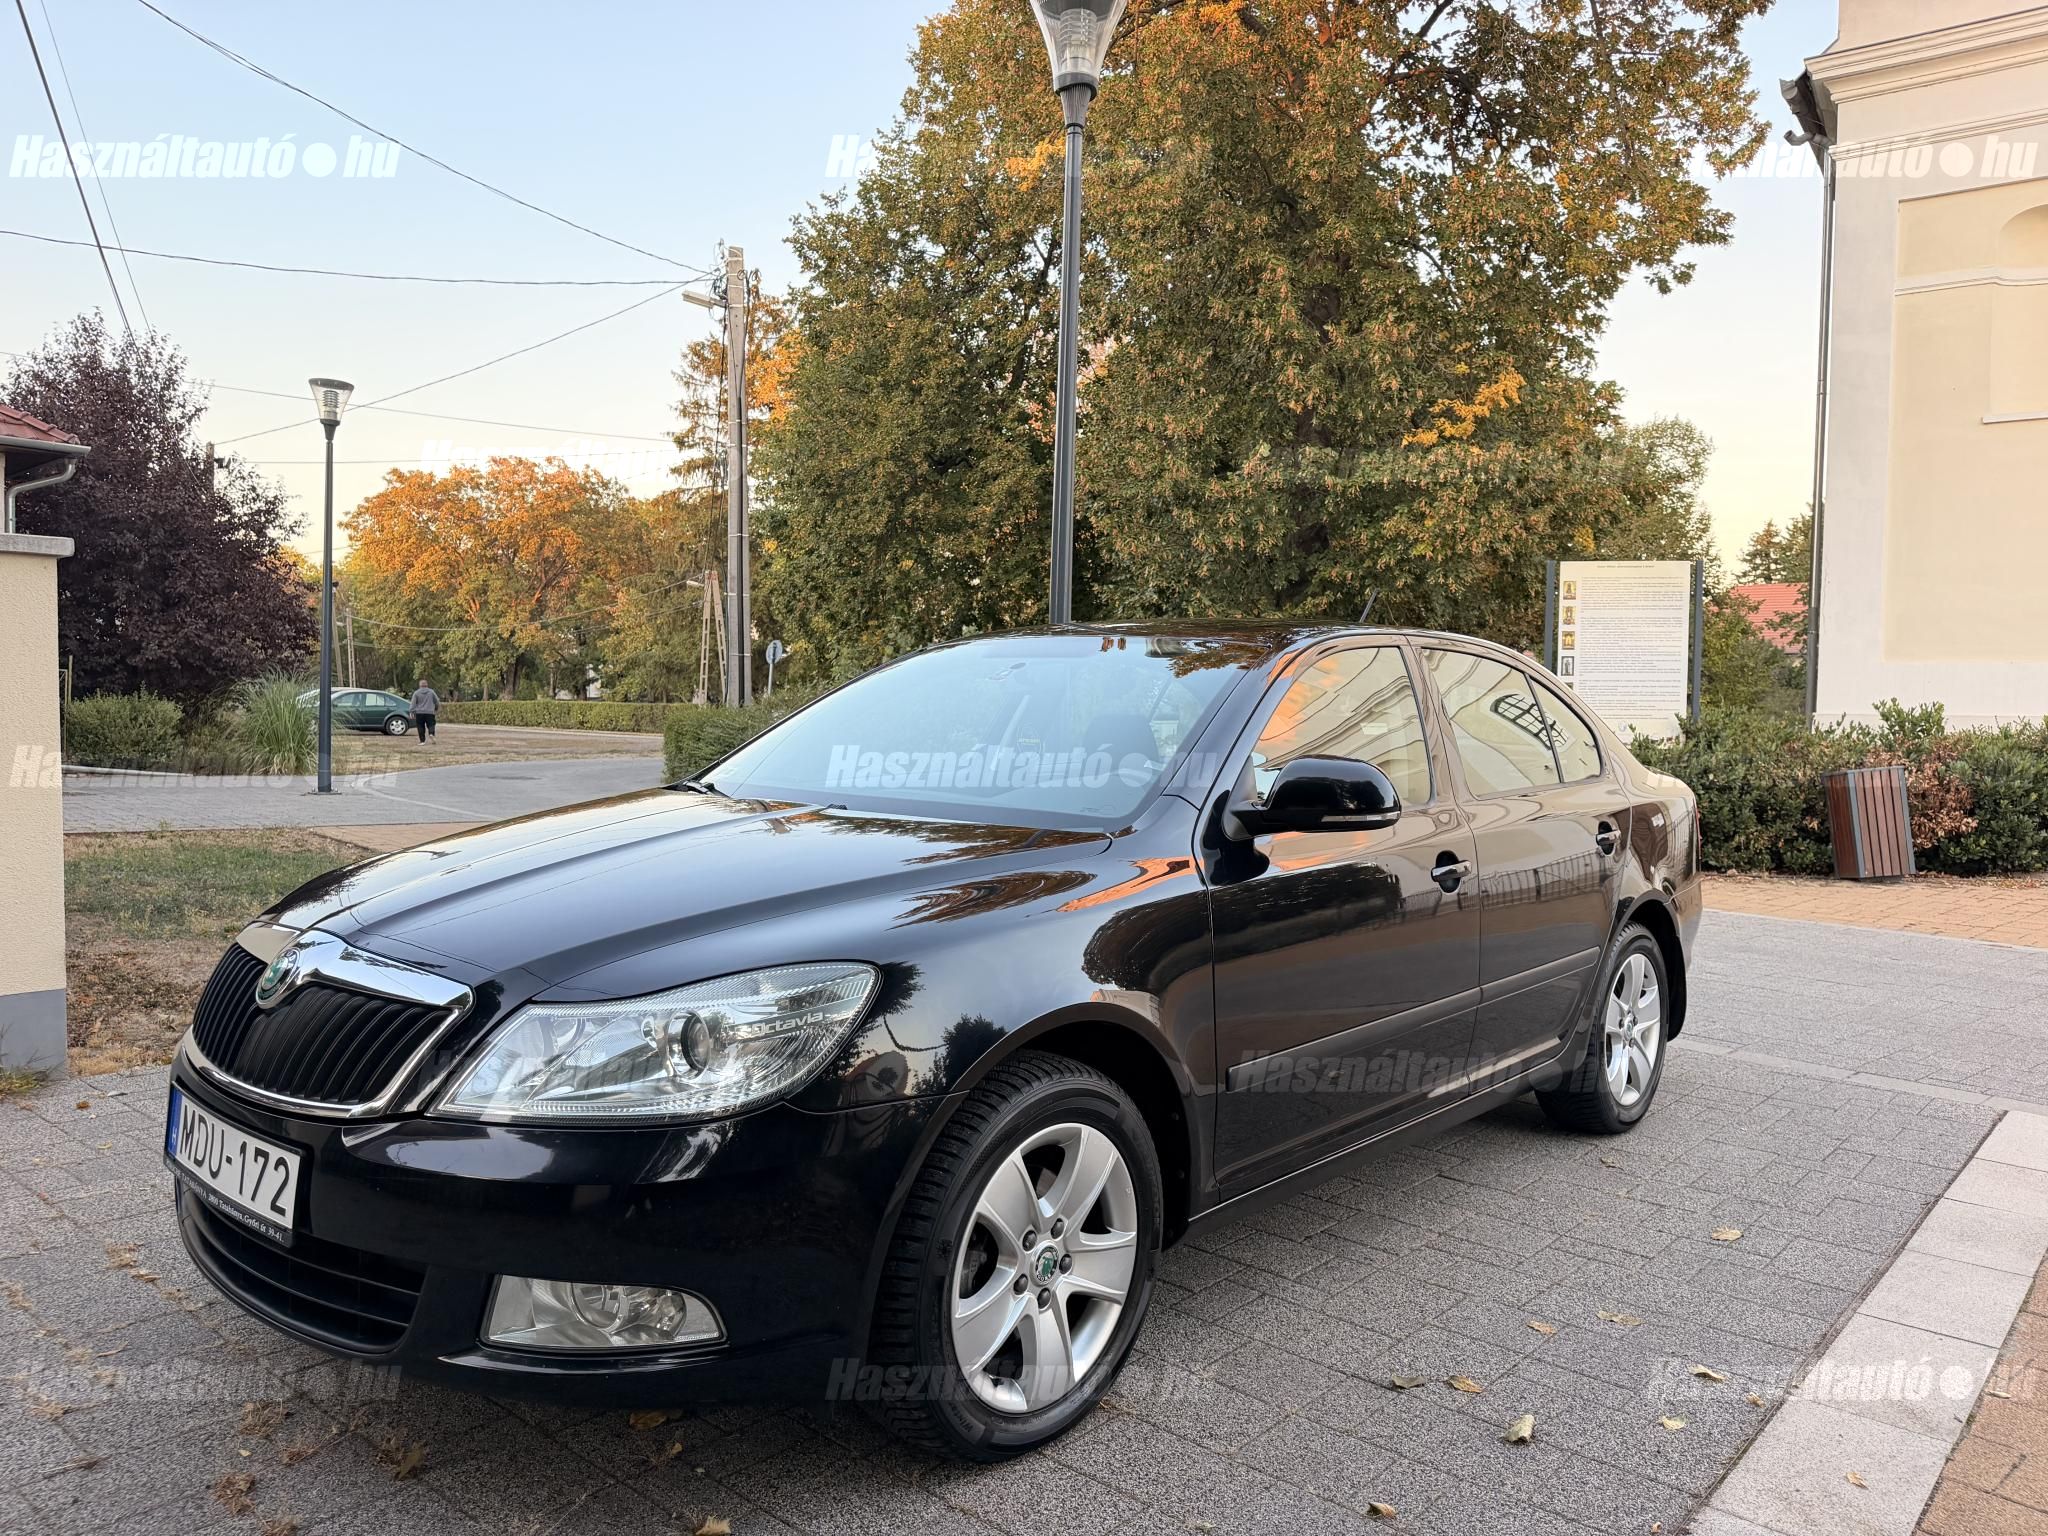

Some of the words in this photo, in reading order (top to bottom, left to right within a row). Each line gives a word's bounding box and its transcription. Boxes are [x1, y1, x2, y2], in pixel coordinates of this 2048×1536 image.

[751, 1011, 824, 1037] Octavia
[171, 1128, 177, 1145] H
[179, 1104, 290, 1217] MDU-172
